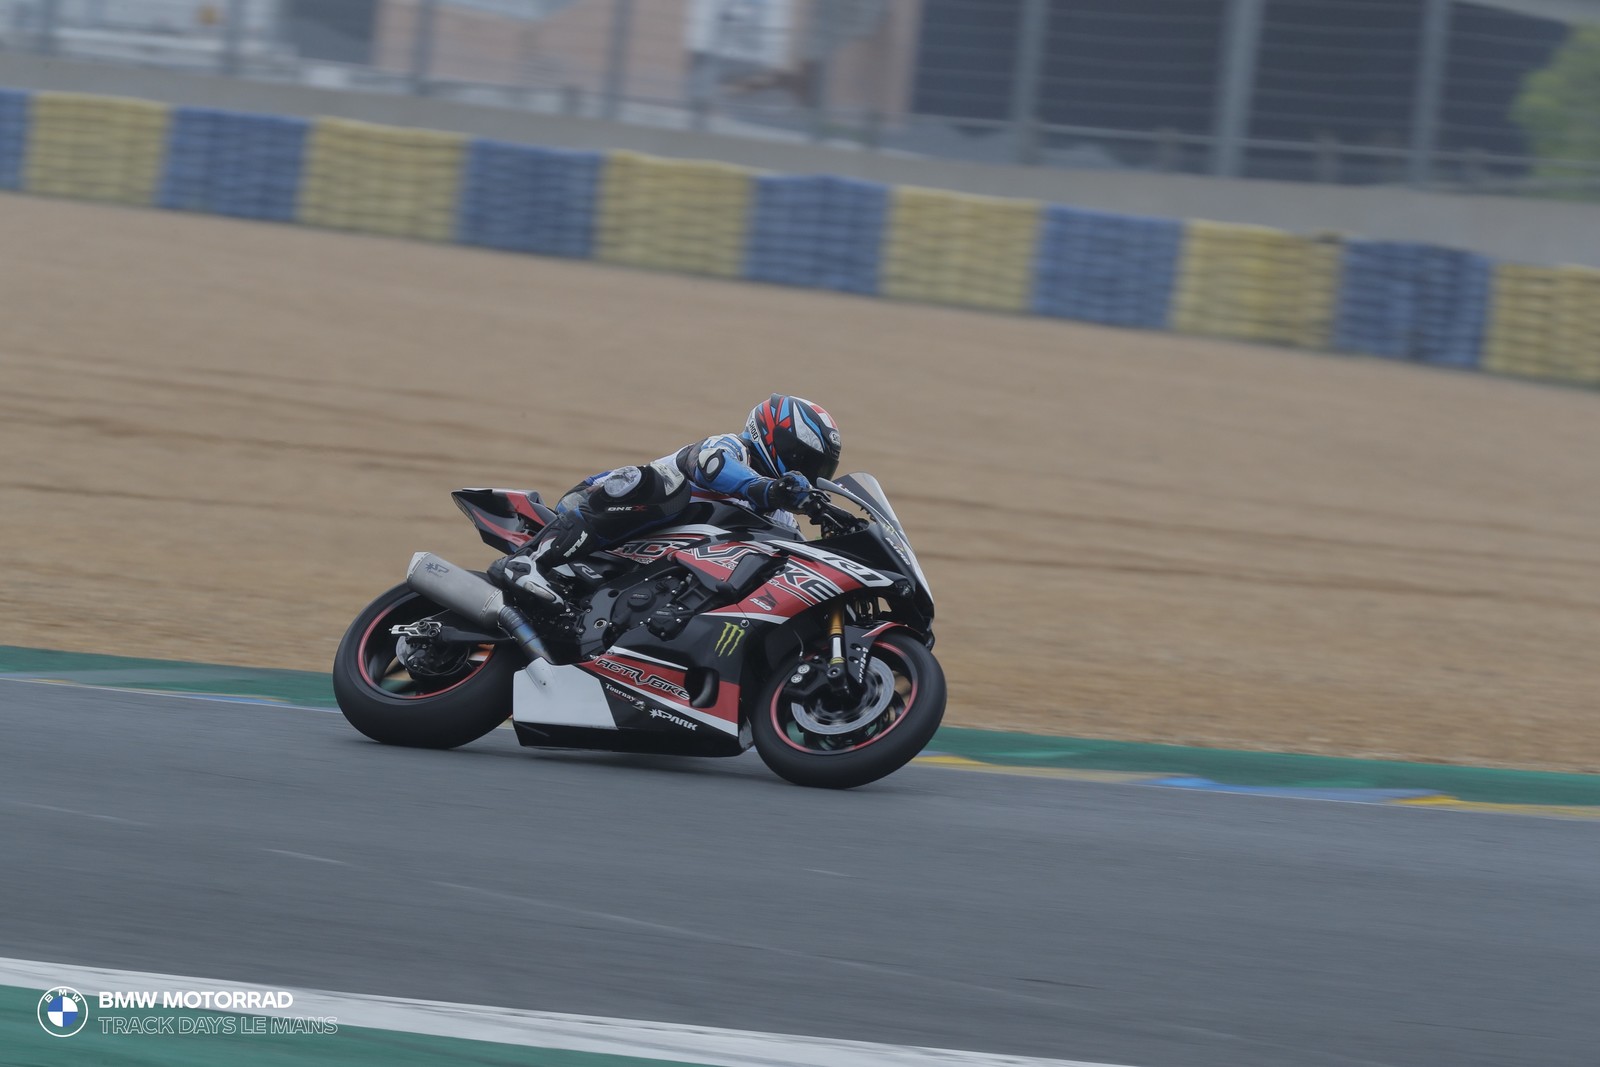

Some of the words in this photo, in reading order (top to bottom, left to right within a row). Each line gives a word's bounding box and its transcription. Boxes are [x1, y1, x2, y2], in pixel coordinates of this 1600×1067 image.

[749, 420, 759, 440] SHOEI
[605, 682, 635, 702] Tournay
[655, 708, 698, 731] SPARK
